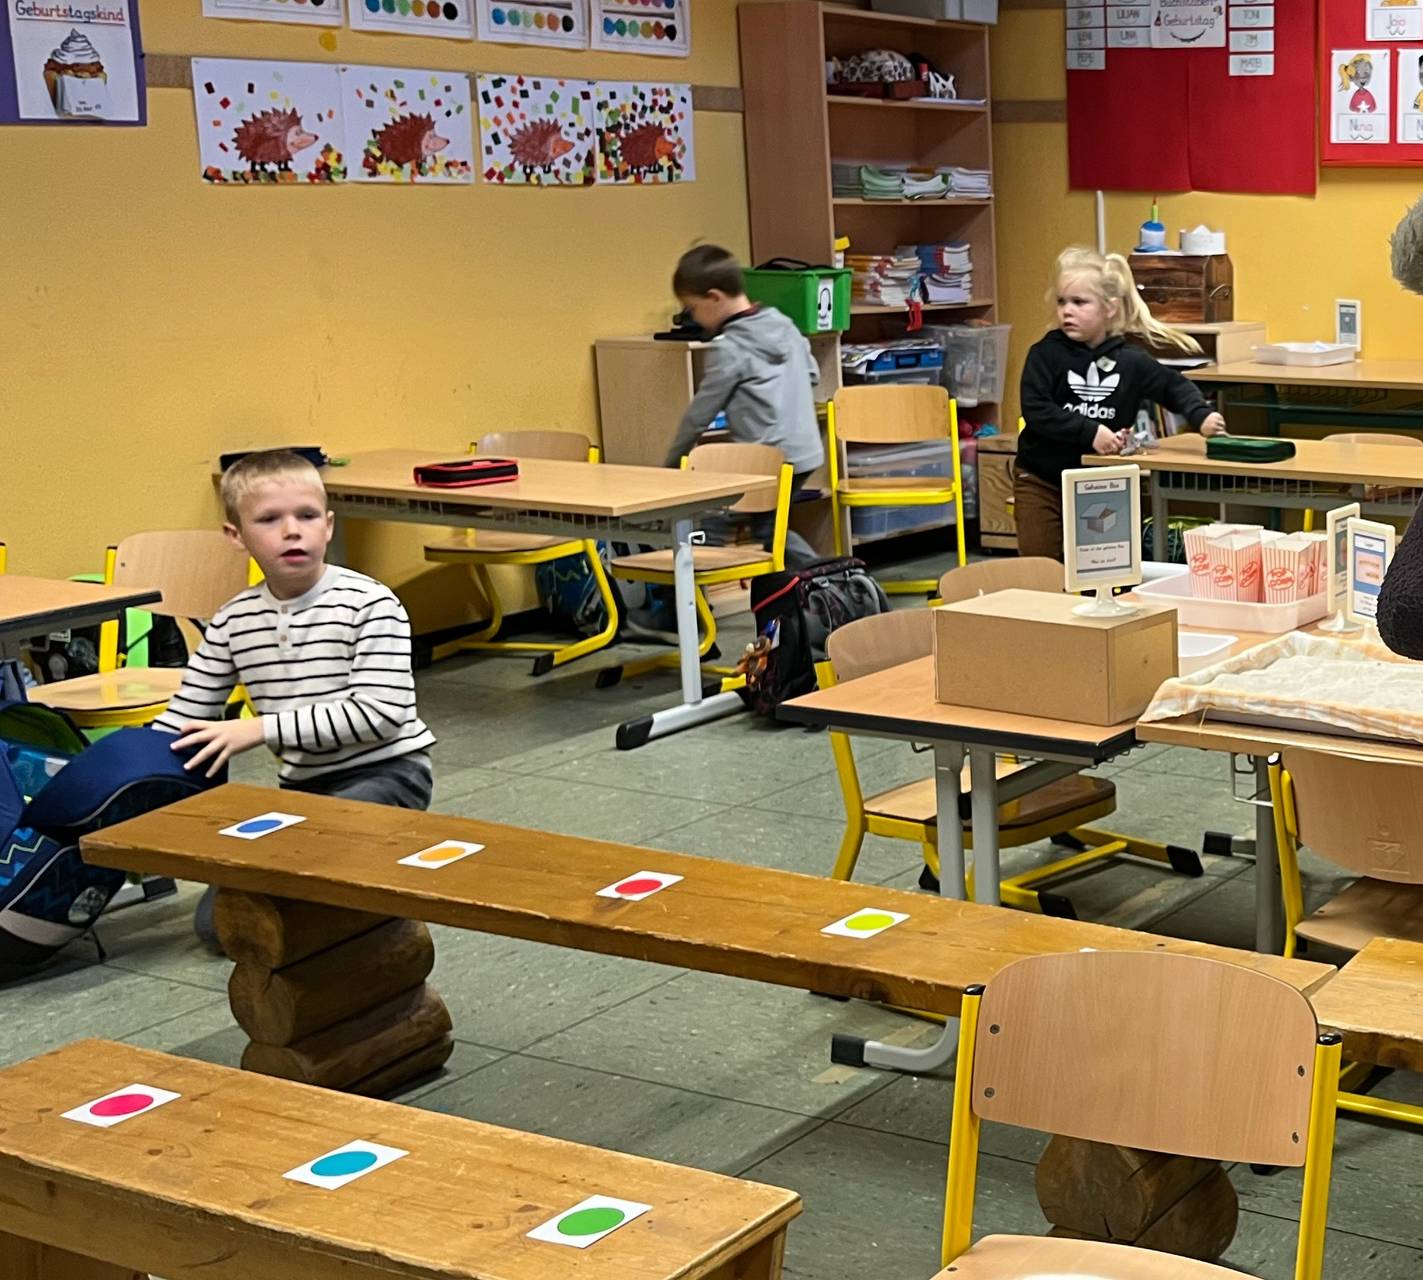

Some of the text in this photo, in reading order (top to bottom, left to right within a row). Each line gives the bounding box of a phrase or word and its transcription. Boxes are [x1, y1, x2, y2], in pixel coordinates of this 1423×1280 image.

[16, 0, 125, 23] Geburtstagskind
[1164, 14, 1216, 28] Geburtstag
[1063, 402, 1116, 419] adidas
